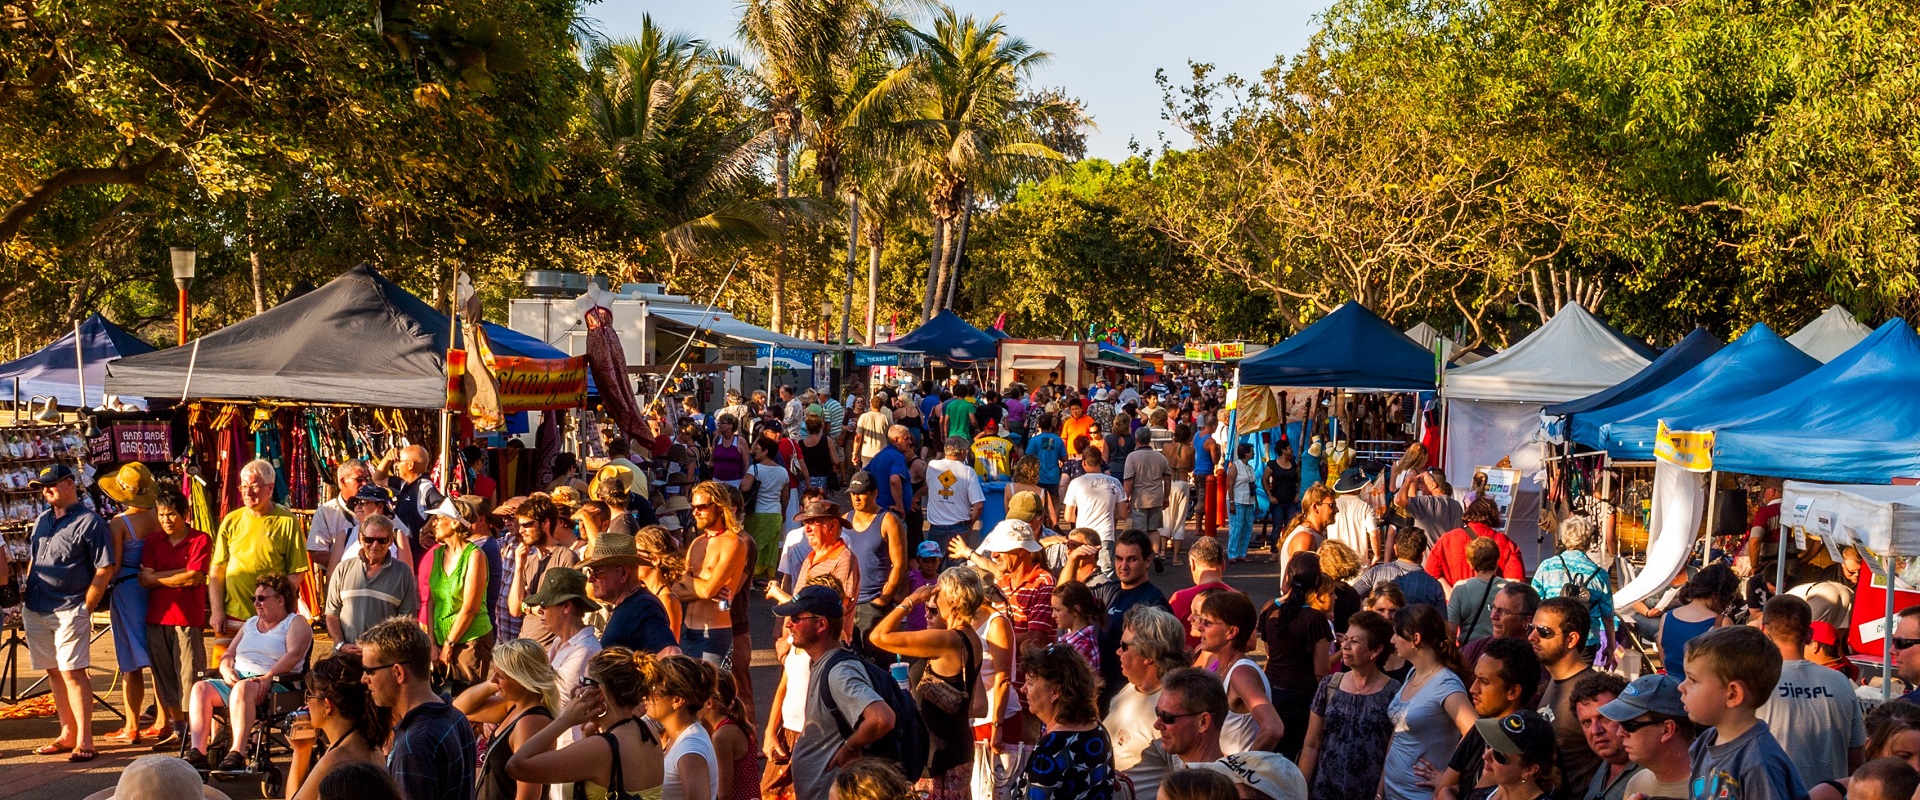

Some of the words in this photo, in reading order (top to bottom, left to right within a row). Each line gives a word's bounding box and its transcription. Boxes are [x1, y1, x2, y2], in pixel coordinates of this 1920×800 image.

[762, 347, 779, 355] CAP
[497, 361, 549, 395] sland
[122, 431, 143, 440] HAND
[144, 431, 165, 440] MADE
[143, 443, 170, 455] DOLLS
